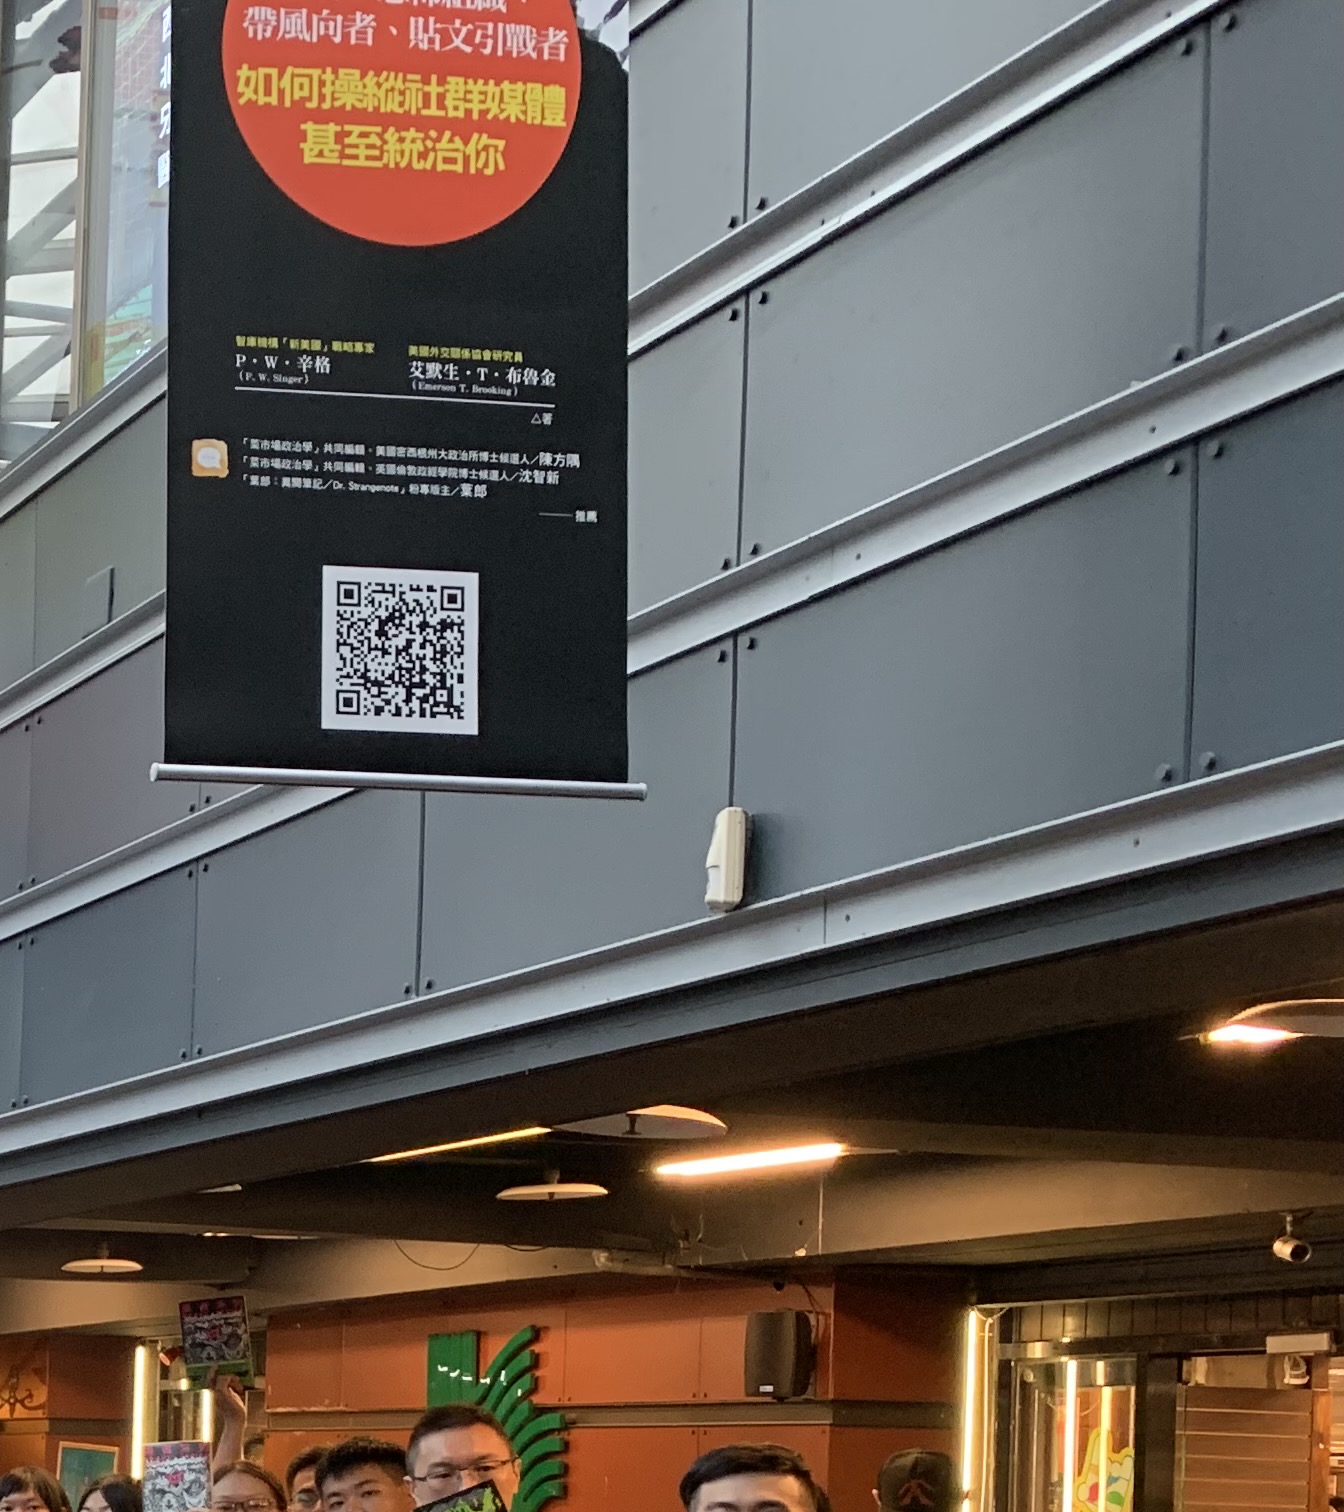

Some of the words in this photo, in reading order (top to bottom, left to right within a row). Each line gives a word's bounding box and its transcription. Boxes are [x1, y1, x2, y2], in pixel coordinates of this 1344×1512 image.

[243, 8, 569, 62] 帶風向者、貼文引戰者
[236, 64, 567, 127] 如何操縱社群媒體
[300, 122, 506, 175] 甚至統治你
